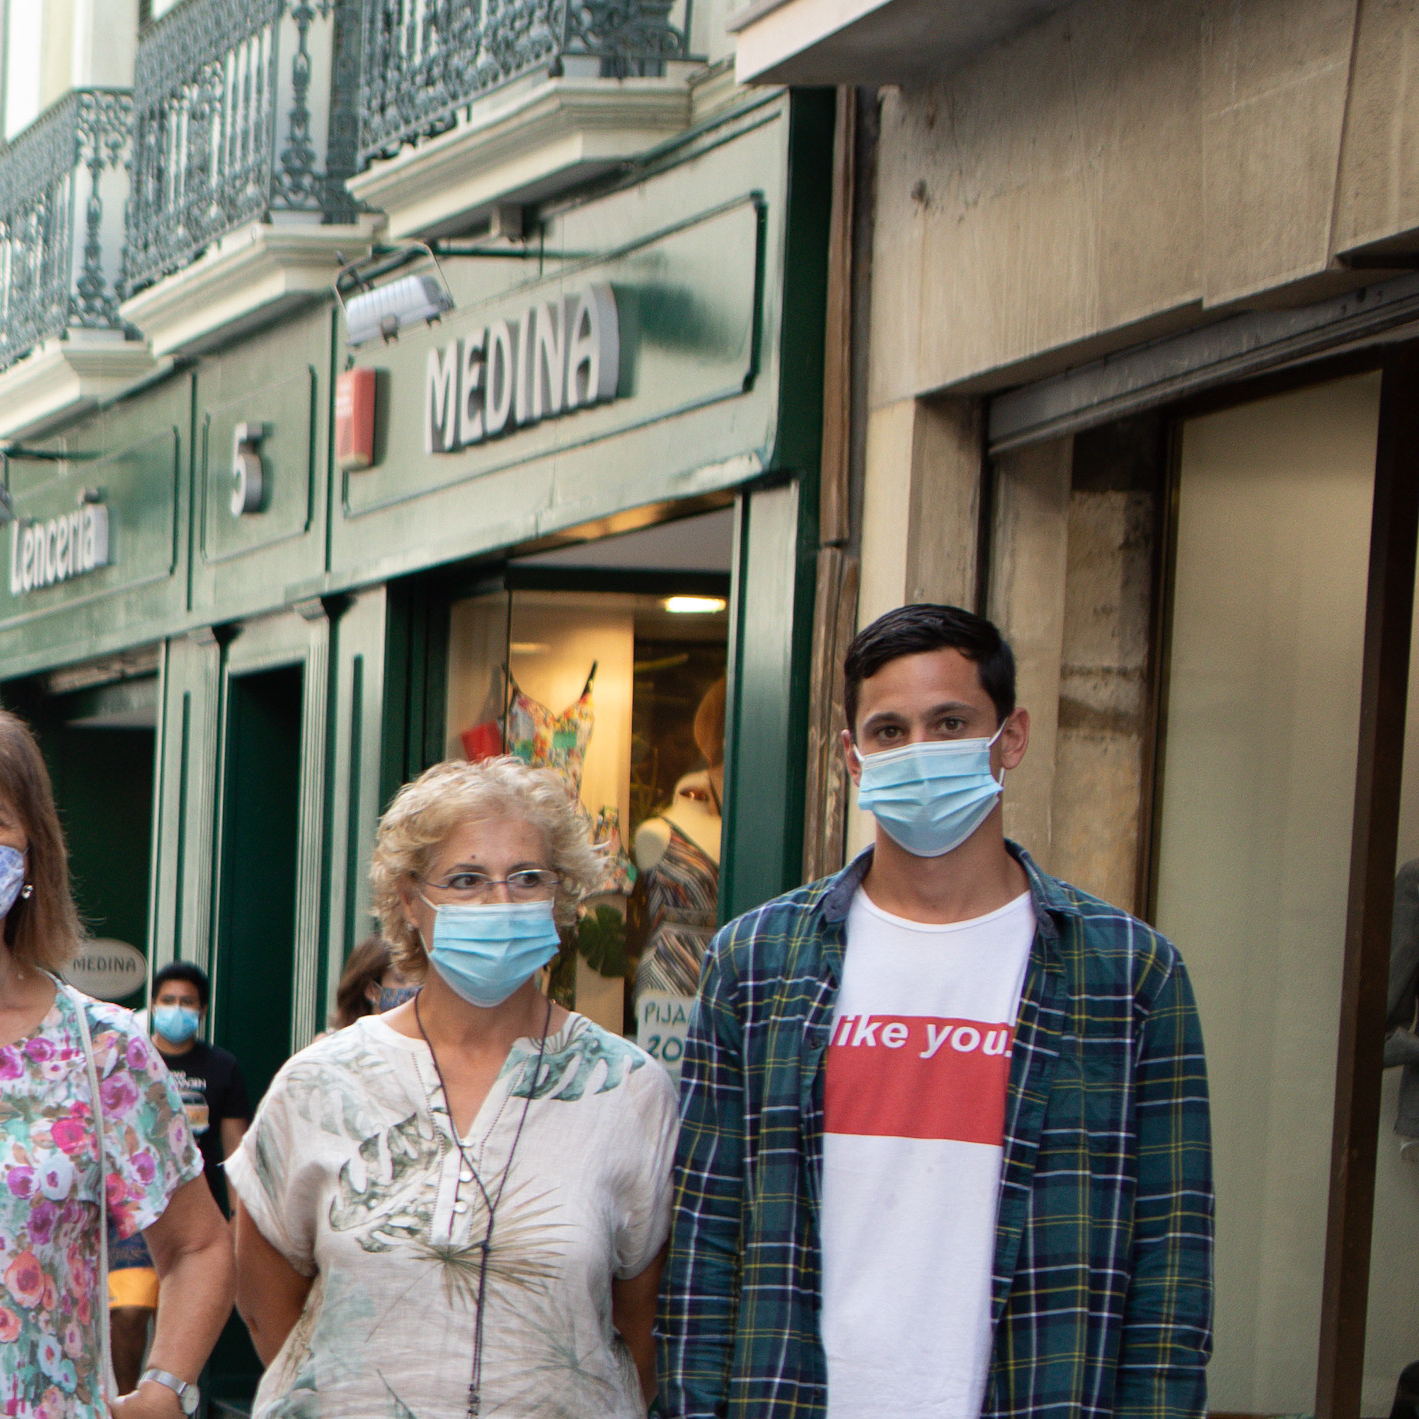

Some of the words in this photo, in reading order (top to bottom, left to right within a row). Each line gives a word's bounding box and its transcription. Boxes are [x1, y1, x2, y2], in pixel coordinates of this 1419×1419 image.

[426, 283, 613, 456] MEDINA
[230, 421, 257, 517] 5
[72, 956, 137, 973] MEDINA
[644, 1001, 687, 1025] PIJA
[647, 1034, 683, 1062] 20
